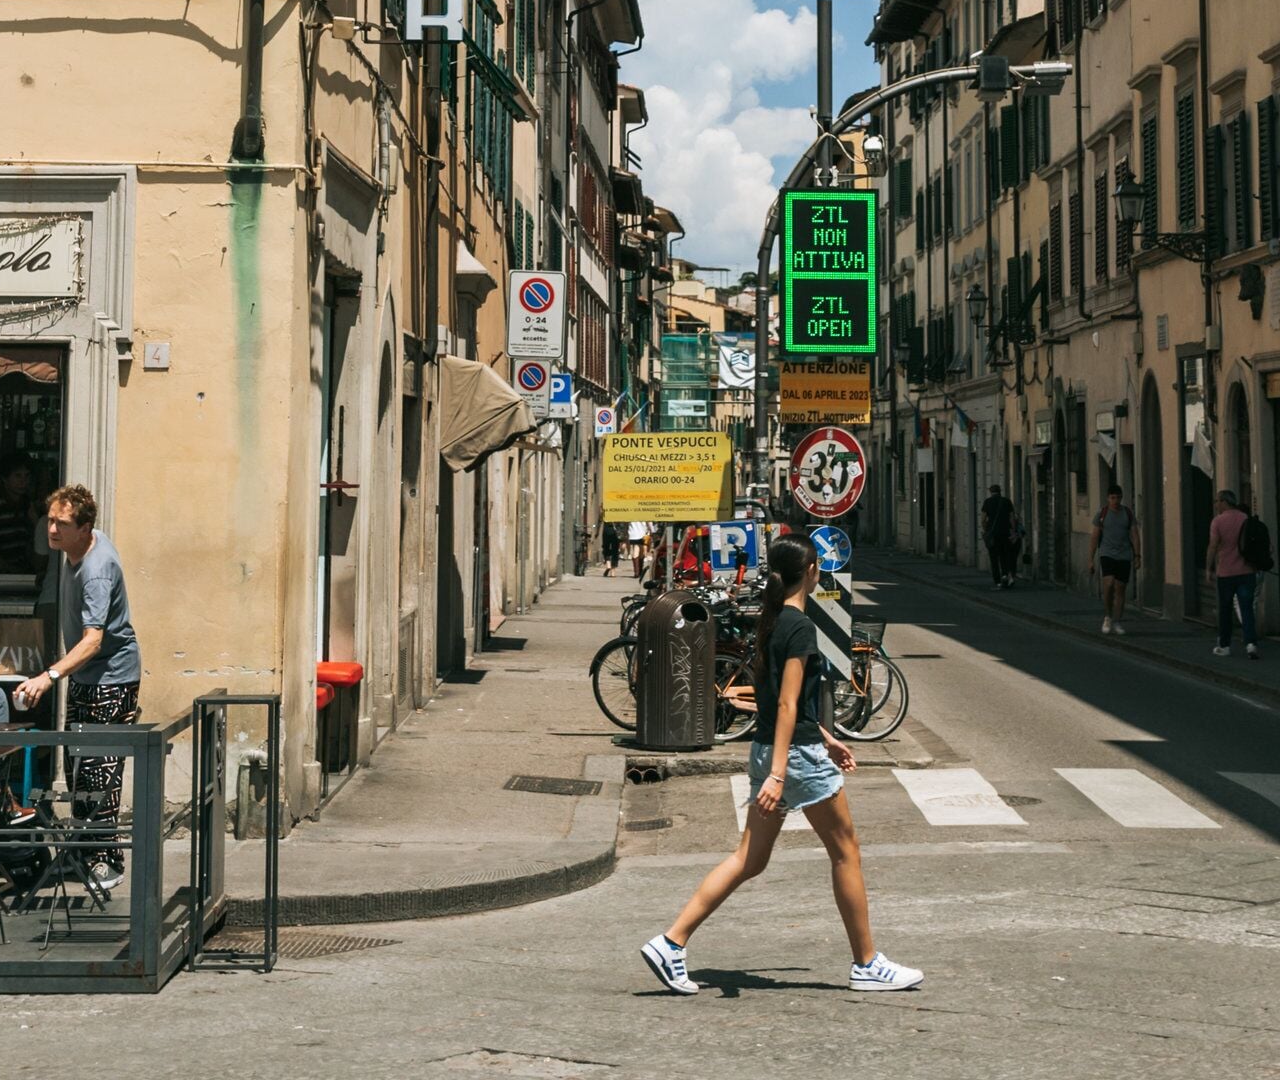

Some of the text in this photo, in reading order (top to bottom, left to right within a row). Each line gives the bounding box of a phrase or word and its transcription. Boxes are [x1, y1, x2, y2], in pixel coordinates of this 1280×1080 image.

[812, 206, 848, 223] ZTL
[814, 228, 847, 246] NON
[794, 251, 864, 269] ATTIVA
[812, 296, 849, 314] ZTL
[807, 319, 852, 336] OPEN
[152, 347, 161, 365] 4
[782, 362, 866, 374] ATTENZIONE
[550, 378, 565, 399] P
[782, 389, 869, 400] DAL 06 APRILE 2023
[782, 413, 805, 422] INIZIO
[823, 413, 865, 422] NOTTURNA
[612, 437, 717, 448] PONTE VESPUCCI
[613, 453, 647, 461] CHIUSO
[660, 453, 687, 461] MEZZI
[697, 453, 710, 462] 3,5
[624, 465, 665, 473] 25/01/2021
[634, 476, 695, 484] ORARIO 00-24
[719, 526, 747, 564] P
